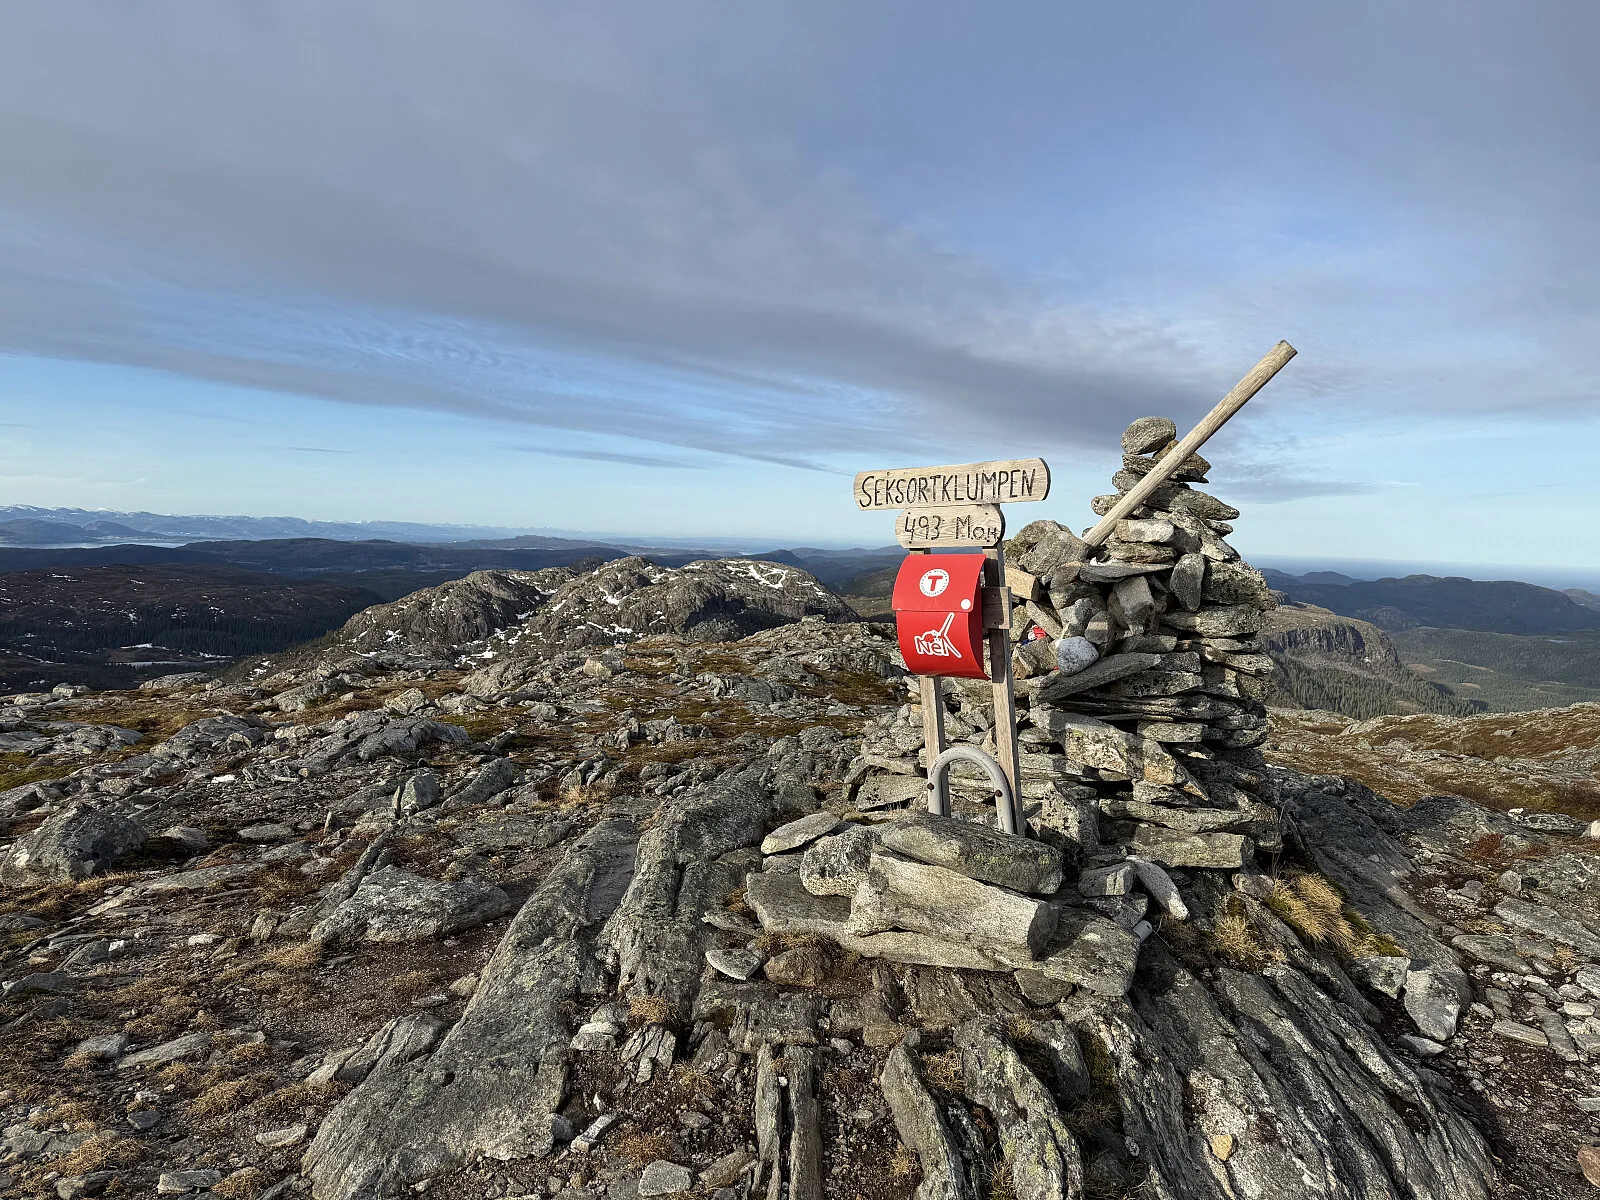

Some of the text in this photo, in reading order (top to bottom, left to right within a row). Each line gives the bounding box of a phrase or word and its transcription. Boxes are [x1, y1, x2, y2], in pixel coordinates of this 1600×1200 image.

[859, 468, 1036, 508] SEKSORTKLUMPEN
[905, 516, 940, 540] 493
[928, 575, 943, 591] T
